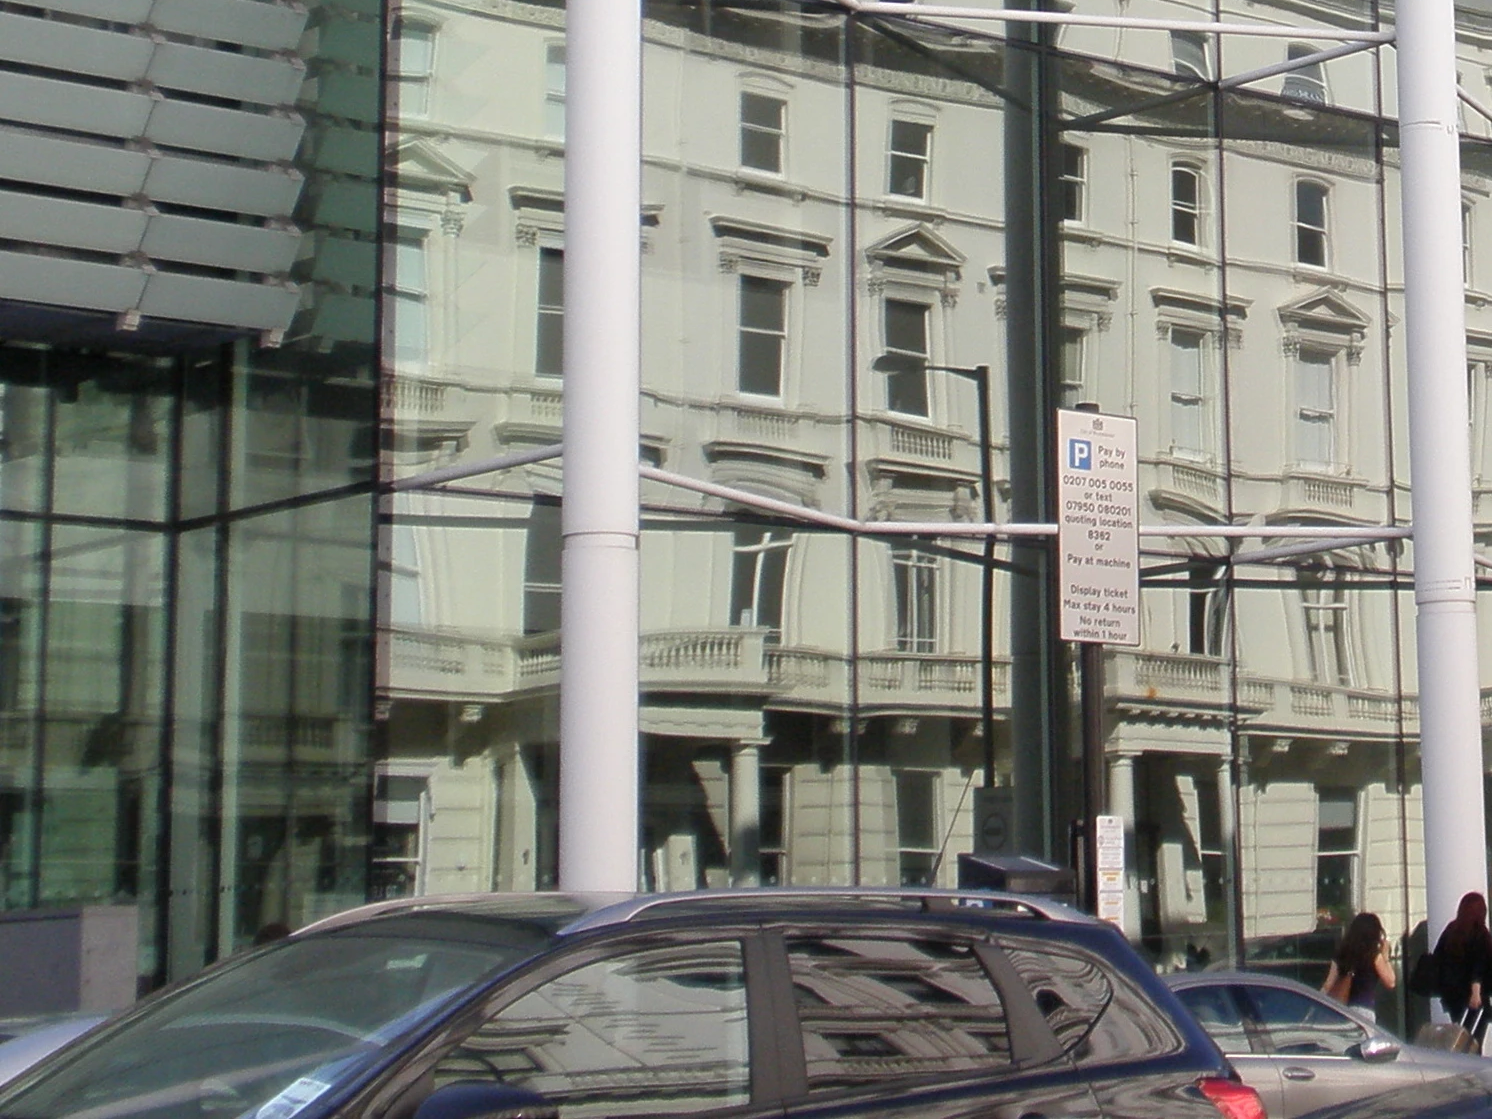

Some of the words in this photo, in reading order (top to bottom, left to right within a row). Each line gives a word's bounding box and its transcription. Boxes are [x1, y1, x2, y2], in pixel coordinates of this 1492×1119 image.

[1074, 442, 1088, 467] P
[1098, 445, 1113, 457] Pay
[1115, 447, 1126, 459] by
[1099, 459, 1124, 470] phone
[1063, 475, 1087, 486] 0207
[1088, 478, 1107, 489] 005
[1109, 480, 1133, 492] 0055
[1084, 492, 1093, 500] or
[1095, 492, 1113, 502] text
[1066, 500, 1095, 512] 07950
[1097, 504, 1131, 516] 080201
[1065, 515, 1096, 527] quoting
[1099, 516, 1132, 529] location
[1094, 543, 1104, 551] or
[1067, 553, 1083, 566] Pay
[1085, 556, 1094, 565] at
[1096, 558, 1131, 569] machine
[1070, 584, 1101, 598] Display
[1103, 588, 1128, 599] ticket
[1063, 599, 1081, 610] Max
[1083, 602, 1101, 613] stay
[1104, 602, 1110, 612] 4
[1112, 603, 1136, 614] hours
[1079, 615, 1092, 626] No
[1094, 617, 1121, 627] return
[1073, 628, 1099, 639] within
[1108, 630, 1128, 640] hour
